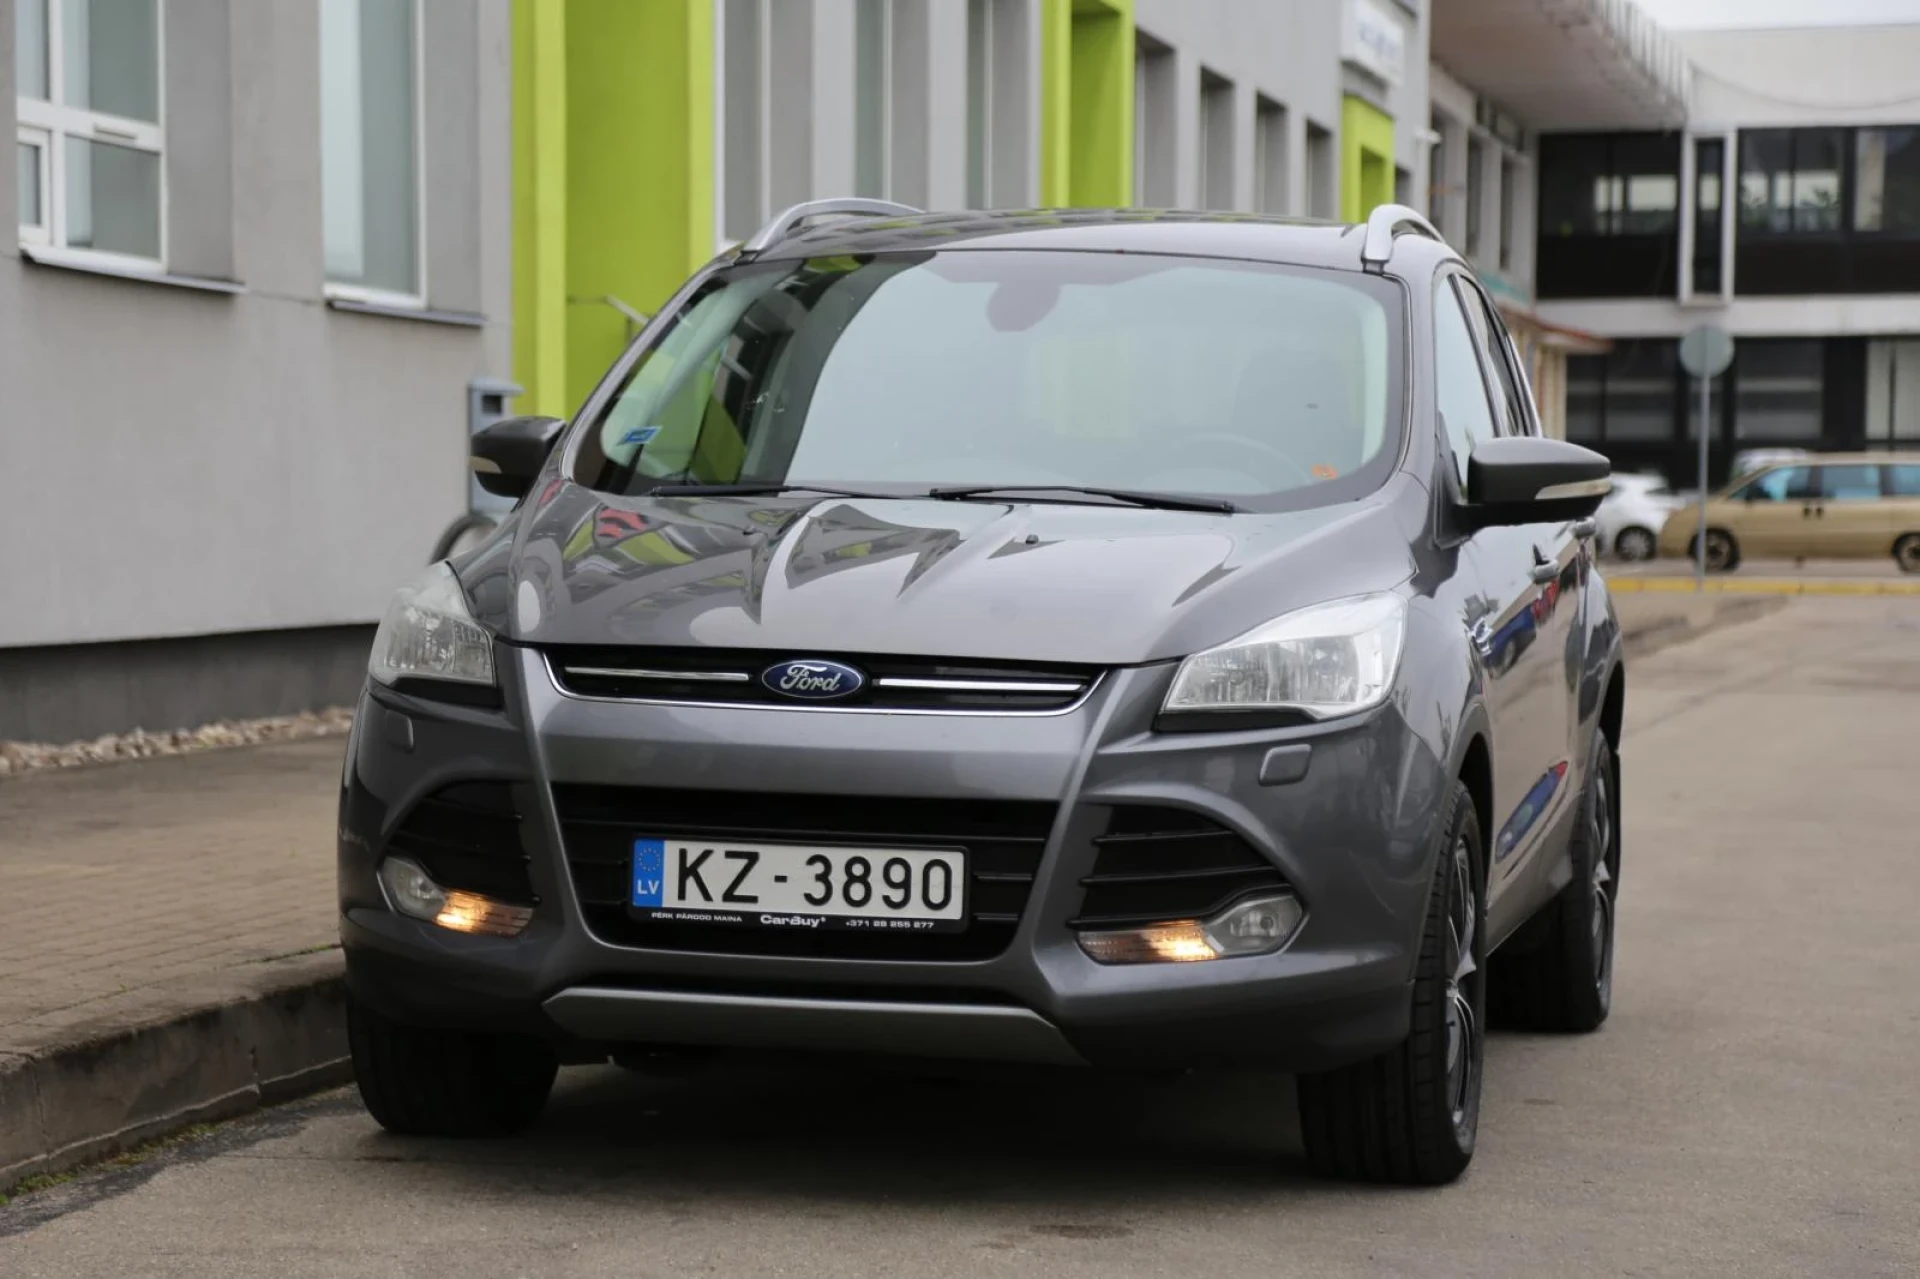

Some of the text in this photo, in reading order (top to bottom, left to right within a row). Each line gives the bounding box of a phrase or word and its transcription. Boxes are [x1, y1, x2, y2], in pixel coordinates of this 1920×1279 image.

[780, 664, 842, 691] Ford
[637, 879, 660, 895] LV
[677, 848, 953, 911] KZ-3890
